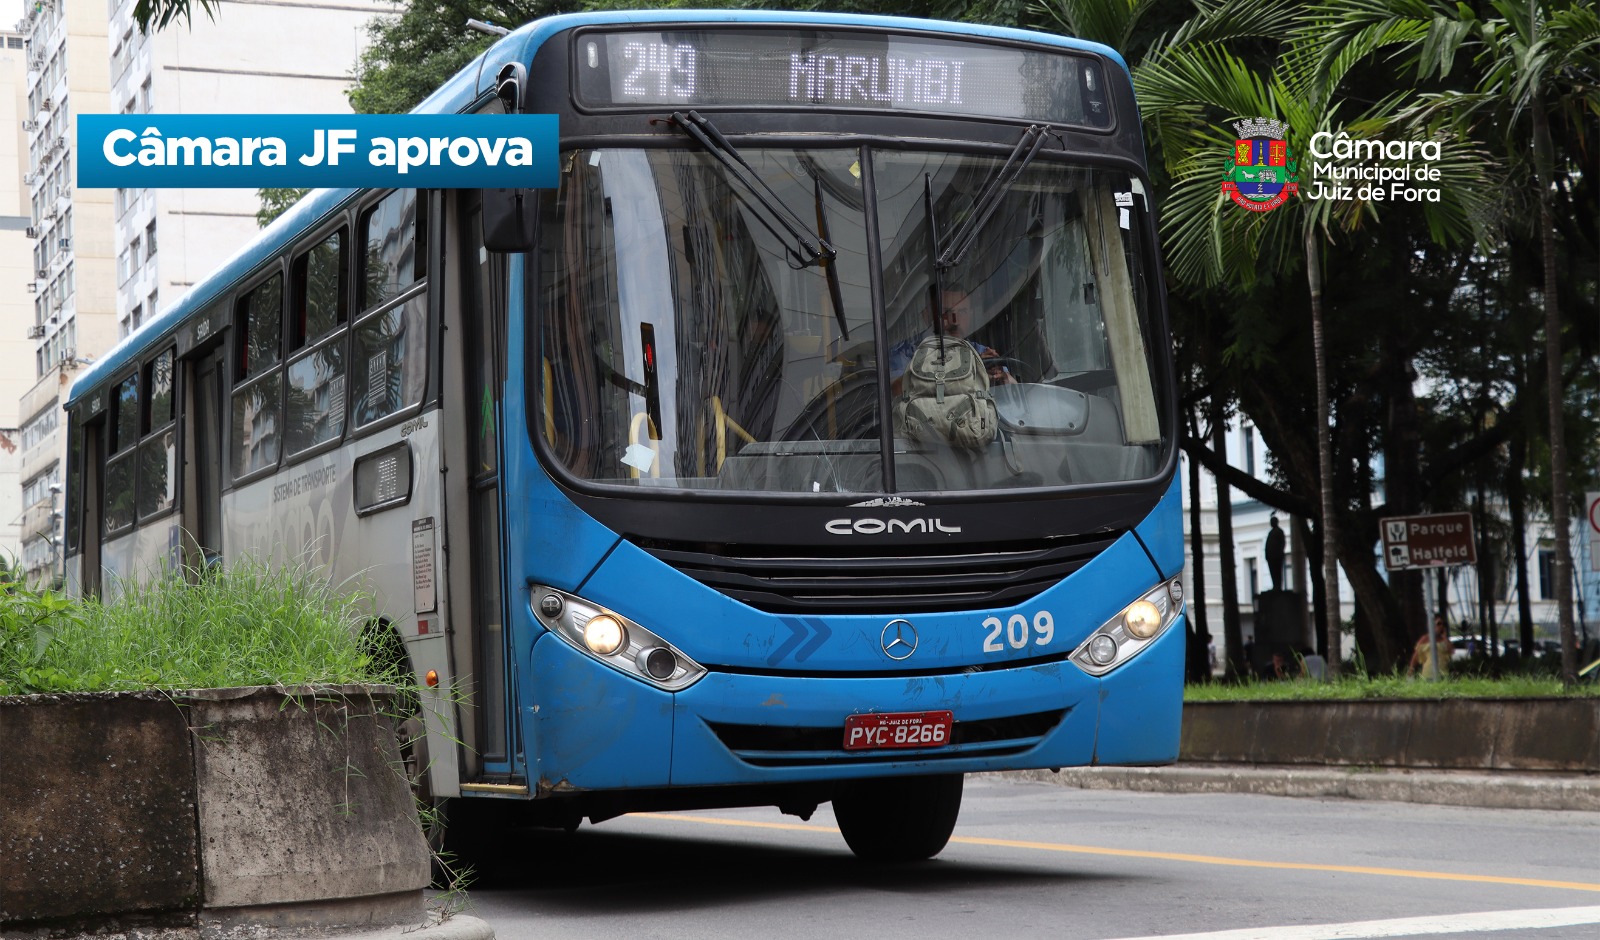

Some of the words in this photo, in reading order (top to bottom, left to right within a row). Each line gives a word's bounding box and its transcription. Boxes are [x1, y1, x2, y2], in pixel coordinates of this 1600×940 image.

[622, 42, 697, 97] 249
[789, 52, 965, 105] MARUMBI
[294, 478, 301, 496] DE
[301, 464, 336, 493] TRANSPORTE
[825, 517, 963, 536] COMIL
[1410, 523, 1463, 536] Parque
[1412, 545, 1468, 560] Halfeld
[981, 610, 1055, 653] 209
